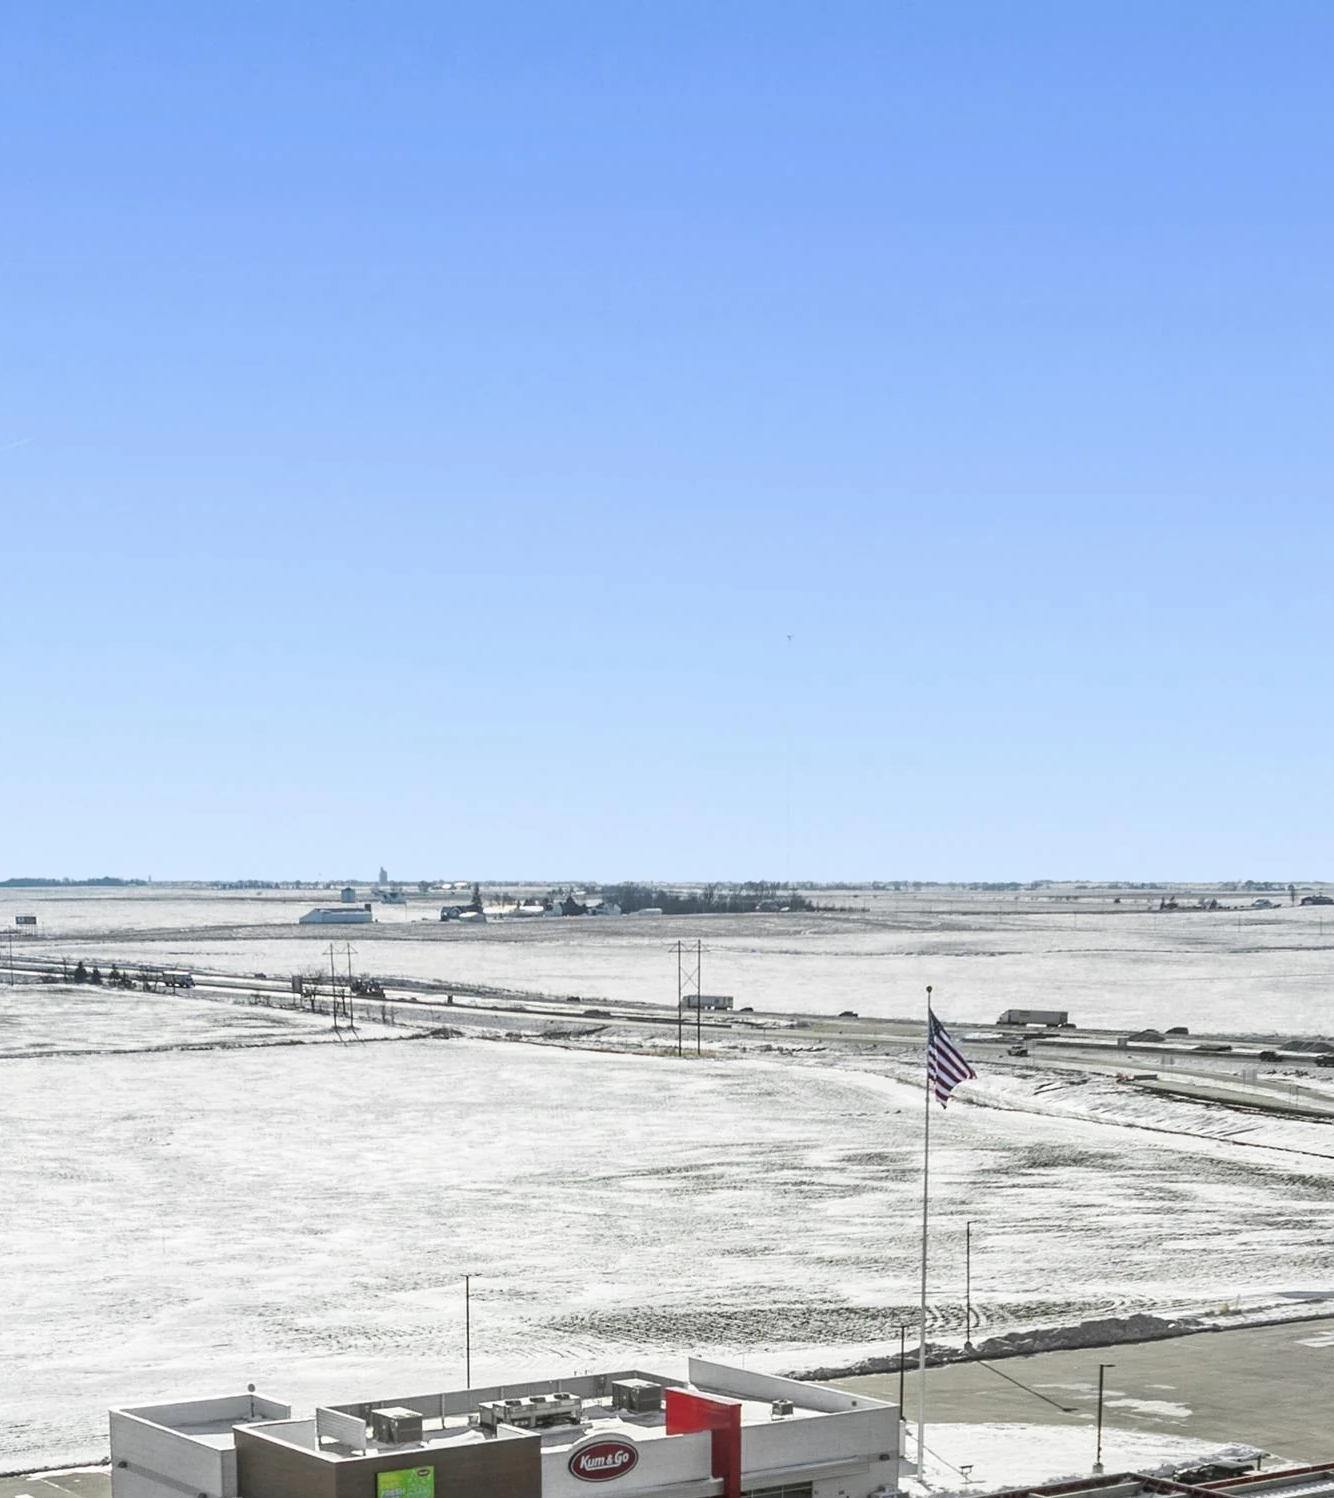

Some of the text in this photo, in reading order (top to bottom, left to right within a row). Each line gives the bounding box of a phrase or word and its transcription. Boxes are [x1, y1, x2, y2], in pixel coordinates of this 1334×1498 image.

[580, 1451, 630, 1471] Kum & Go
